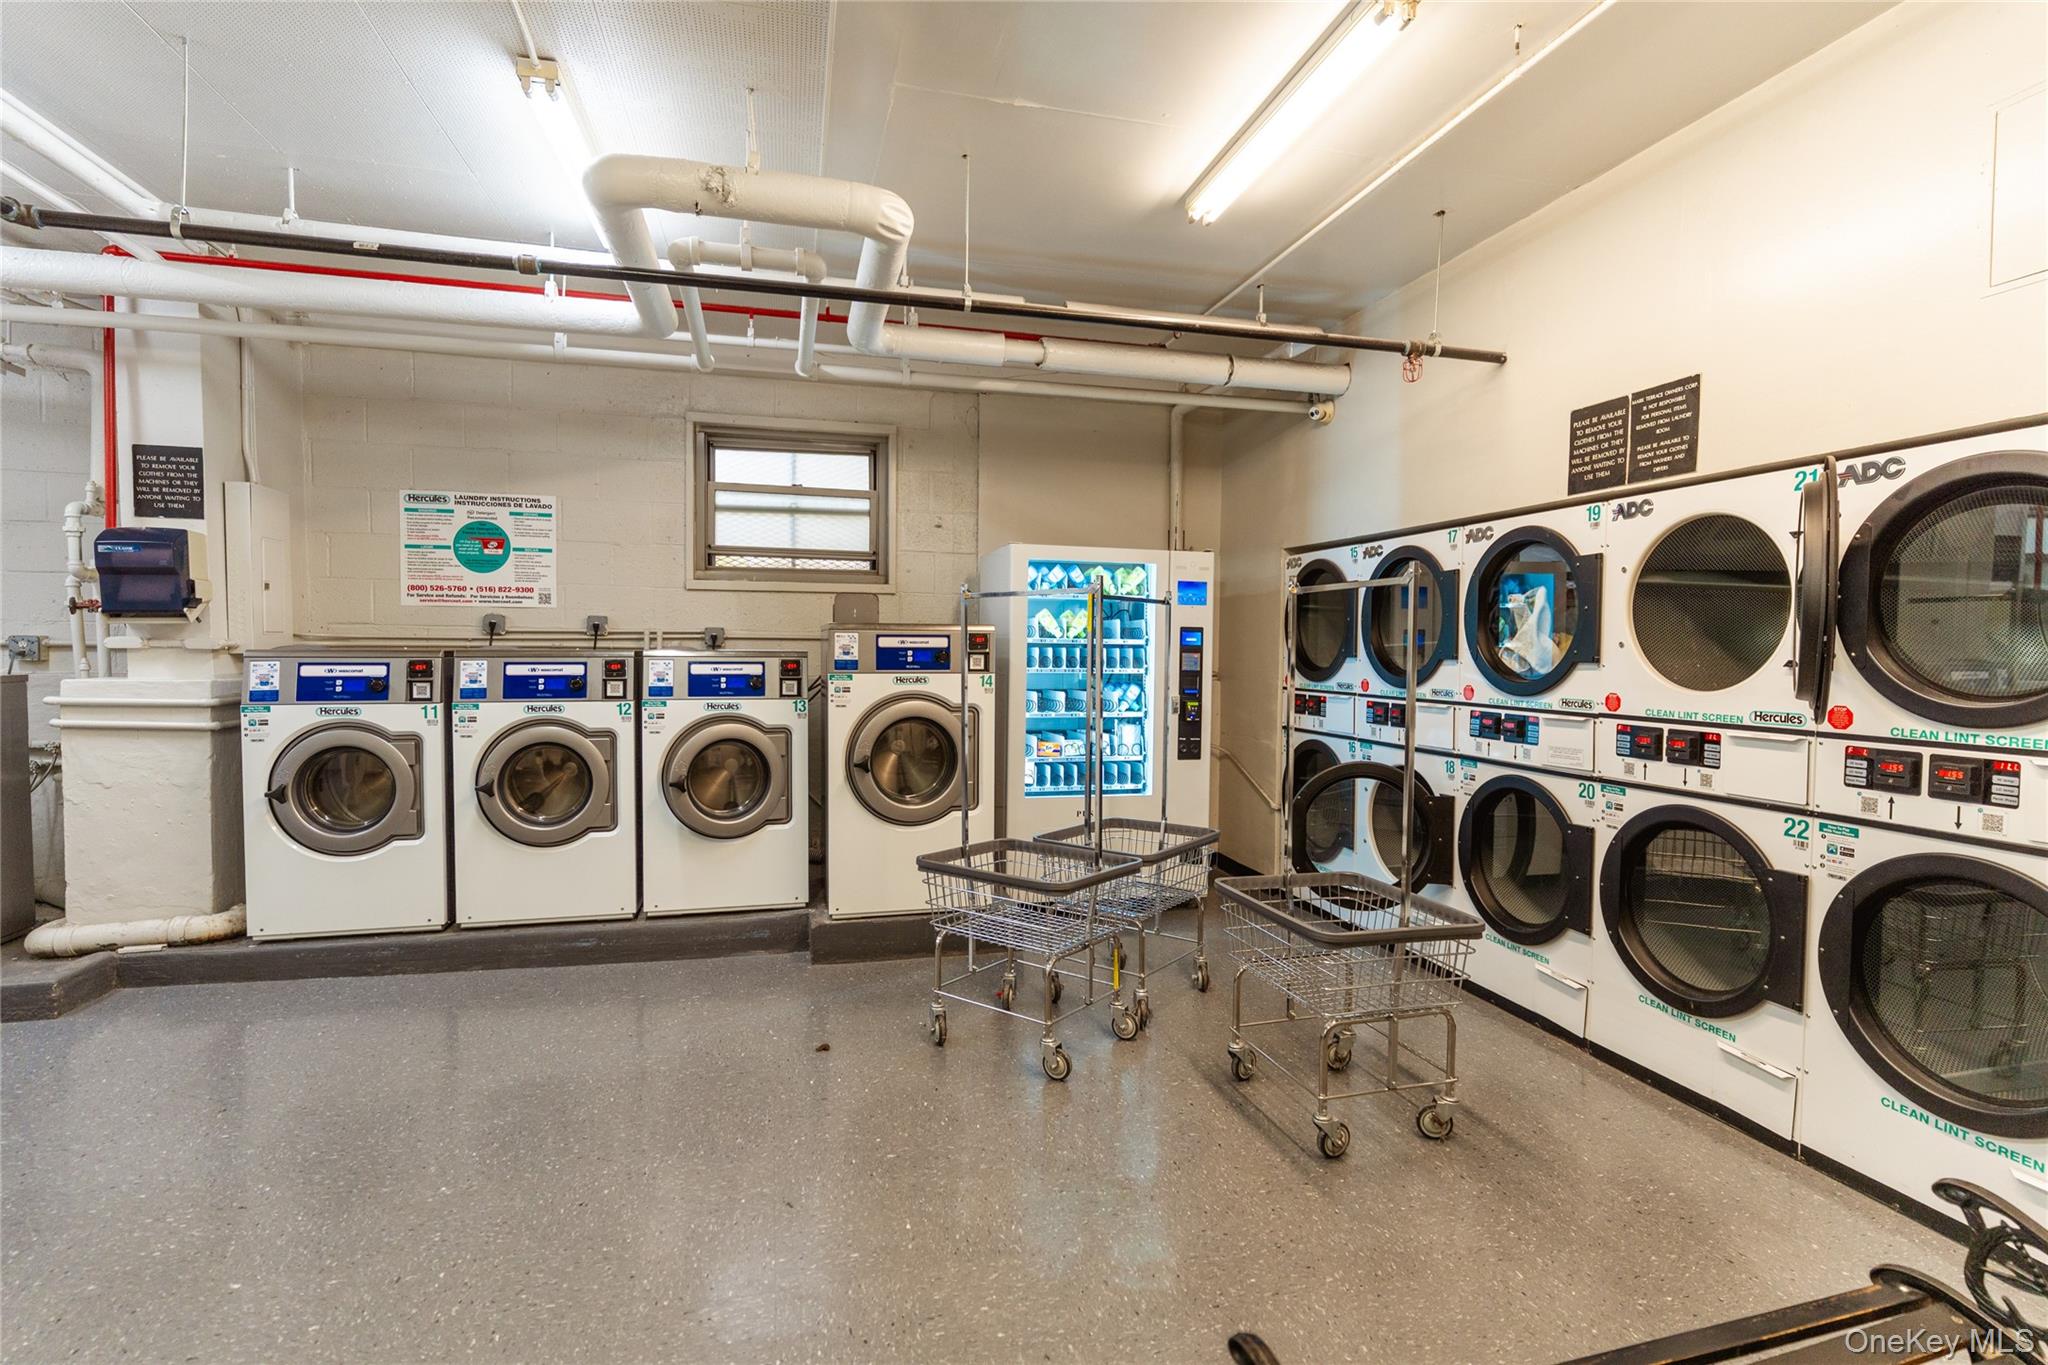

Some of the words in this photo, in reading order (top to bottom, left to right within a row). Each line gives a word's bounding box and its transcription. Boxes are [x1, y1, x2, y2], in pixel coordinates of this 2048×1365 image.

[1665, 386, 1684, 396] OWNERS
[1648, 402, 1657, 410] NOT
[1659, 395, 1686, 406] RESPONSIBLE
[1574, 419, 1590, 428] PLEASE
[1600, 409, 1626, 421] AVAILABLE
[1651, 408, 1672, 418] PERSONAL
[1586, 424, 1605, 434] REMOVE
[1608, 419, 1622, 428] YOUR
[1636, 421, 1656, 430] REMOVED
[1658, 417, 1670, 425] FROM
[1672, 412, 1692, 422] LAUNDRY
[1574, 437, 1595, 446] CLOTHES
[1597, 432, 1612, 440] FROM
[1660, 437, 1681, 446] AVAILABLE
[1573, 445, 1599, 455] MACHINES
[1611, 438, 1624, 446] THEY
[1637, 452, 1654, 460] REMOVE
[1656, 448, 1667, 456] YOUR
[1669, 444, 1688, 453] CLOTHES
[1592, 449, 1617, 460] REMOVED
[1653, 456, 1672, 464] WASHERS
[1571, 465, 1591, 474] ANYONE
[1594, 460, 1615, 469] WAITING
[1653, 465, 1668, 473] DRYERS
[1838, 457, 1906, 488] ADC
[1595, 470, 1610, 478] THEM
[1794, 468, 1818, 492] 21
[408, 494, 447, 502] Hercules
[1587, 505, 1600, 522] 19
[1612, 499, 1654, 521] ADC
[1448, 530, 1458, 543] 17
[1465, 526, 1494, 544] ADC
[1350, 546, 1358, 558] 15
[1363, 545, 1384, 560] ADC
[1286, 557, 1302, 570] ADC
[407, 584, 428, 592] (800)
[896, 676, 927, 684] Hercules
[980, 675, 993, 687] 14
[1431, 688, 1454, 697] Hercules
[527, 705, 562, 713] Hercules
[617, 703, 632, 715] 12
[707, 702, 739, 710] Hercules
[792, 699, 806, 712] 13
[1525, 701, 1552, 709] SCREEN
[1561, 699, 1592, 709] Hercules
[320, 707, 358, 715] Hercules
[421, 705, 438, 719] 11
[1645, 708, 1675, 718] CLEAN
[1678, 711, 1699, 720] LINT
[1702, 713, 1744, 724] SCREEN
[1754, 711, 1803, 725] Hercules
[1890, 727, 1939, 741] CLEAN
[1944, 731, 1979, 744] LINT
[1348, 741, 1356, 752] 16
[1445, 760, 1455, 773] 18
[1579, 783, 1595, 799] 20
[1784, 817, 1809, 840] 22
[1485, 933, 1505, 947] CLEAN
[1507, 942, 1521, 953] LINT
[1523, 948, 1549, 965] SCREEN
[1638, 994, 1668, 1014] CLEAN
[1671, 1008, 1693, 1023] LINT
[1695, 1018, 1736, 1042] SCREEN
[1880, 1097, 1930, 1125] CLEAN
[1934, 1119, 1969, 1141] LINT
[1974, 1135, 2045, 1173] SCREEN
